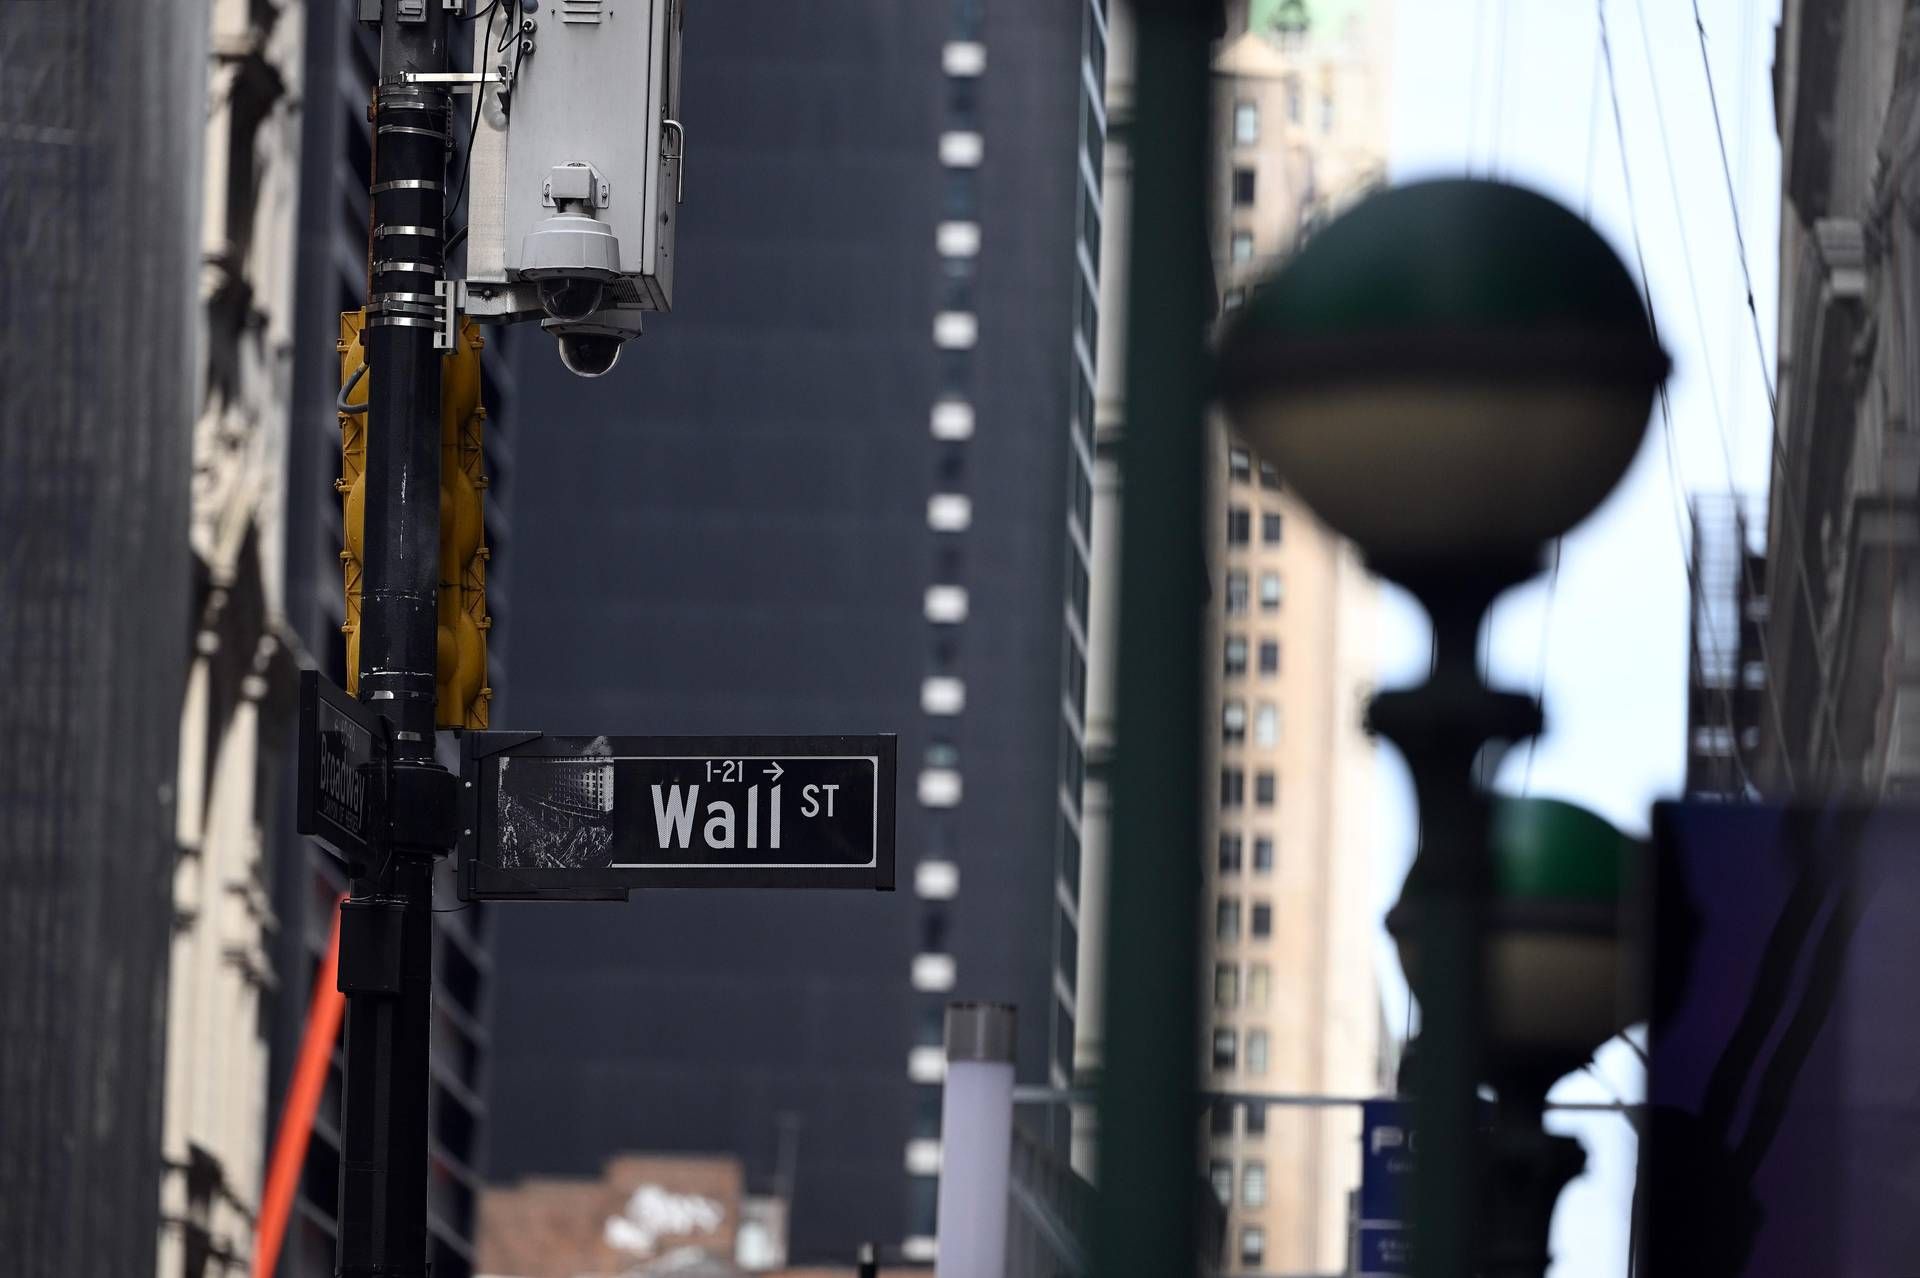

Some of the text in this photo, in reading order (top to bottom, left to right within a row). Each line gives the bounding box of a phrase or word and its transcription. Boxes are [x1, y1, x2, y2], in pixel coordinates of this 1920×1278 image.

[320, 732, 365, 830] Broadway
[706, 760, 743, 783] 1-21
[651, 784, 839, 849] Wall ST
